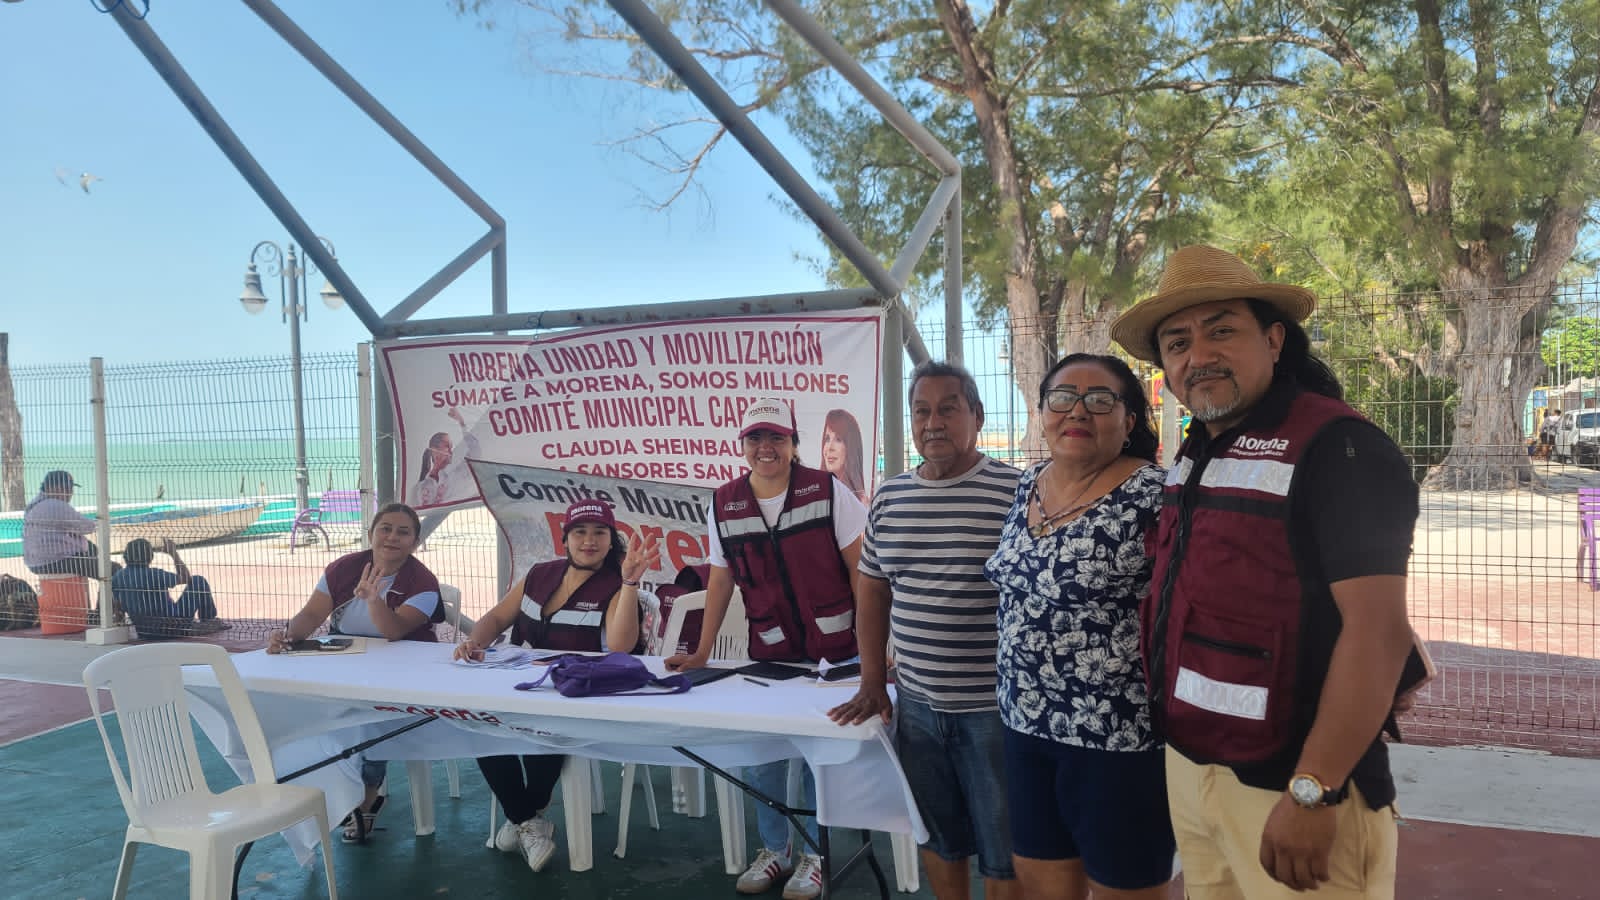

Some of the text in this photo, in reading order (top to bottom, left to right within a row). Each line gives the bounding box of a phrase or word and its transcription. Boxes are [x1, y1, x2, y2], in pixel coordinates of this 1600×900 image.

[448, 323, 823, 383] MORENA UNIDAD Y MOVILIZACIÓN
[431, 371, 850, 408] SÚMATE A MORENA, SOMOS MILLONES
[488, 394, 580, 437] COMITÉ
[582, 395, 705, 429] MUNICIPAL
[541, 438, 745, 459] CLAUDIA SHEINBAU
[577, 462, 689, 480] SANSORES
[693, 462, 733, 481] SAN
[498, 473, 710, 525] Comite Muni
